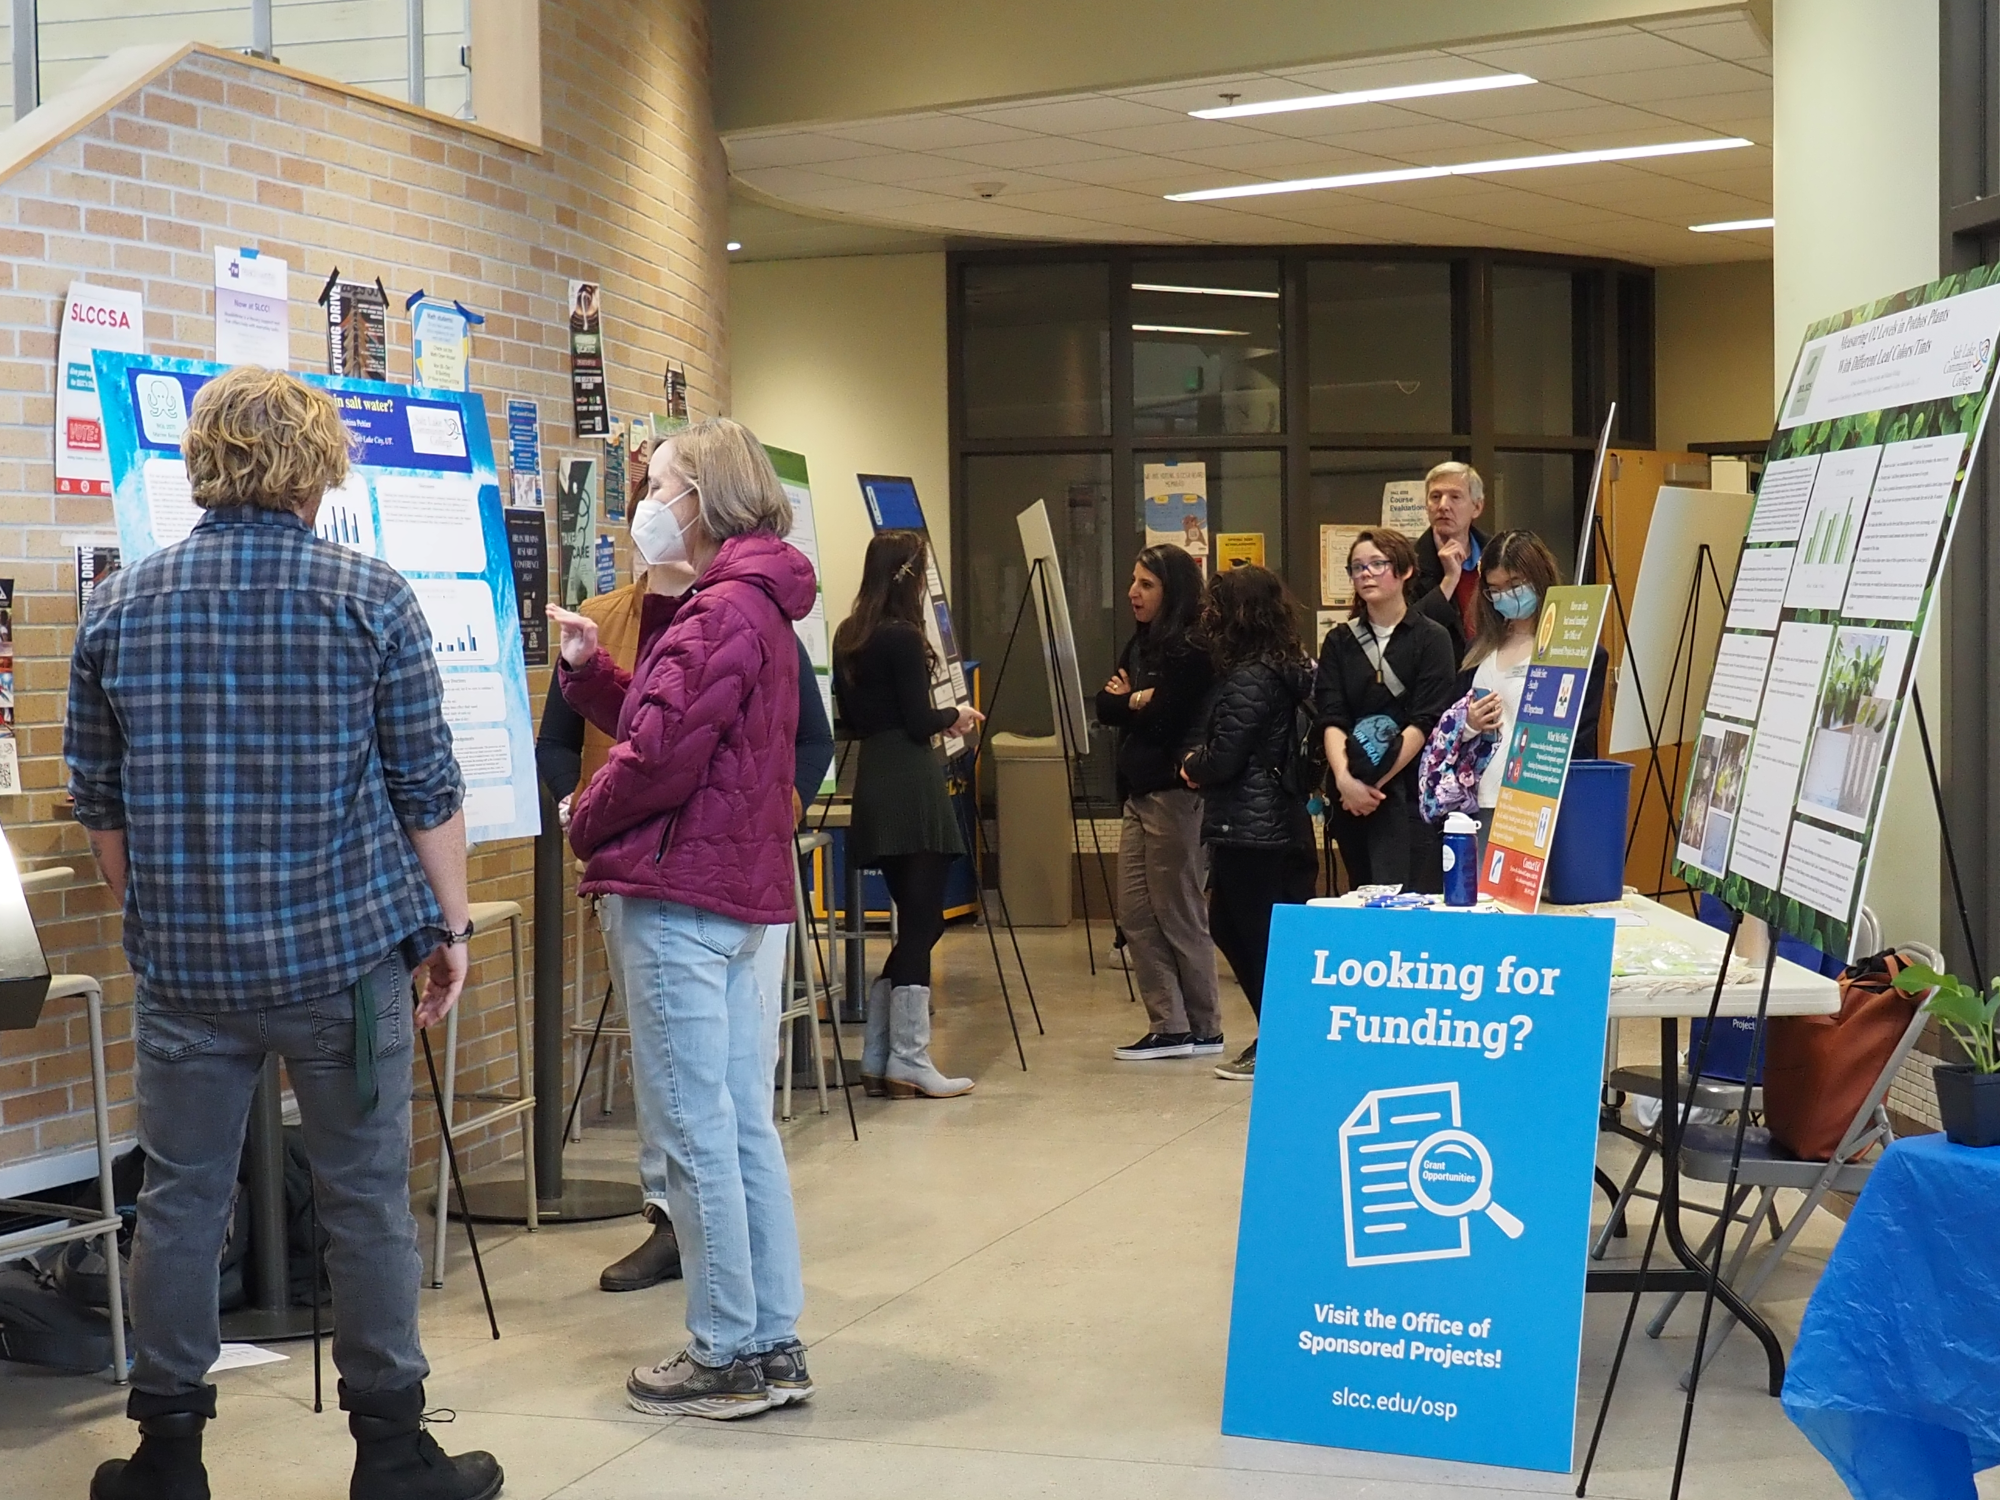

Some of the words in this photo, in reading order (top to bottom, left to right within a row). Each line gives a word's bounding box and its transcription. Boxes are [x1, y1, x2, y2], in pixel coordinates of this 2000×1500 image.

[234, 299, 247, 308] Now
[329, 284, 342, 323] DRIVE
[71, 303, 130, 329] SLCCSA
[1877, 320, 1898, 340] Levels
[1897, 318, 1906, 335] in
[1927, 308, 1950, 326] Plants
[331, 325, 343, 375] OTHING
[1838, 357, 1852, 374] With
[1851, 353, 1878, 372] Different
[1876, 345, 1894, 366] Leaf
[1952, 371, 1974, 391] College
[333, 394, 344, 408] in
[346, 395, 363, 411] salt
[363, 399, 394, 413] water?
[427, 415, 443, 428] Lake
[363, 436, 374, 445] Lake
[1389, 504, 1427, 512] Evaluation
[561, 532, 576, 546] TAKE
[81, 545, 94, 578] DRIVE
[572, 546, 590, 559] CARE
[514, 560, 540, 570] CONFERENCE
[1311, 950, 1484, 1001] Looking
[1496, 956, 1560, 995] for
[1327, 1006, 1533, 1059] Funding?
[1733, 1018, 1756, 1031] Project
[1424, 1160, 1445, 1170] Grant
[1423, 1170, 1476, 1184] Opportunities
[1315, 1304, 1359, 1326] Visit
[1364, 1308, 1396, 1329] the
[1402, 1312, 1463, 1335] Office
[1468, 1318, 1491, 1338] of
[1299, 1331, 1405, 1359] Sponsored
[1410, 1341, 1501, 1368] Projects!
[1332, 1387, 1457, 1421] slcc.edu/osp
